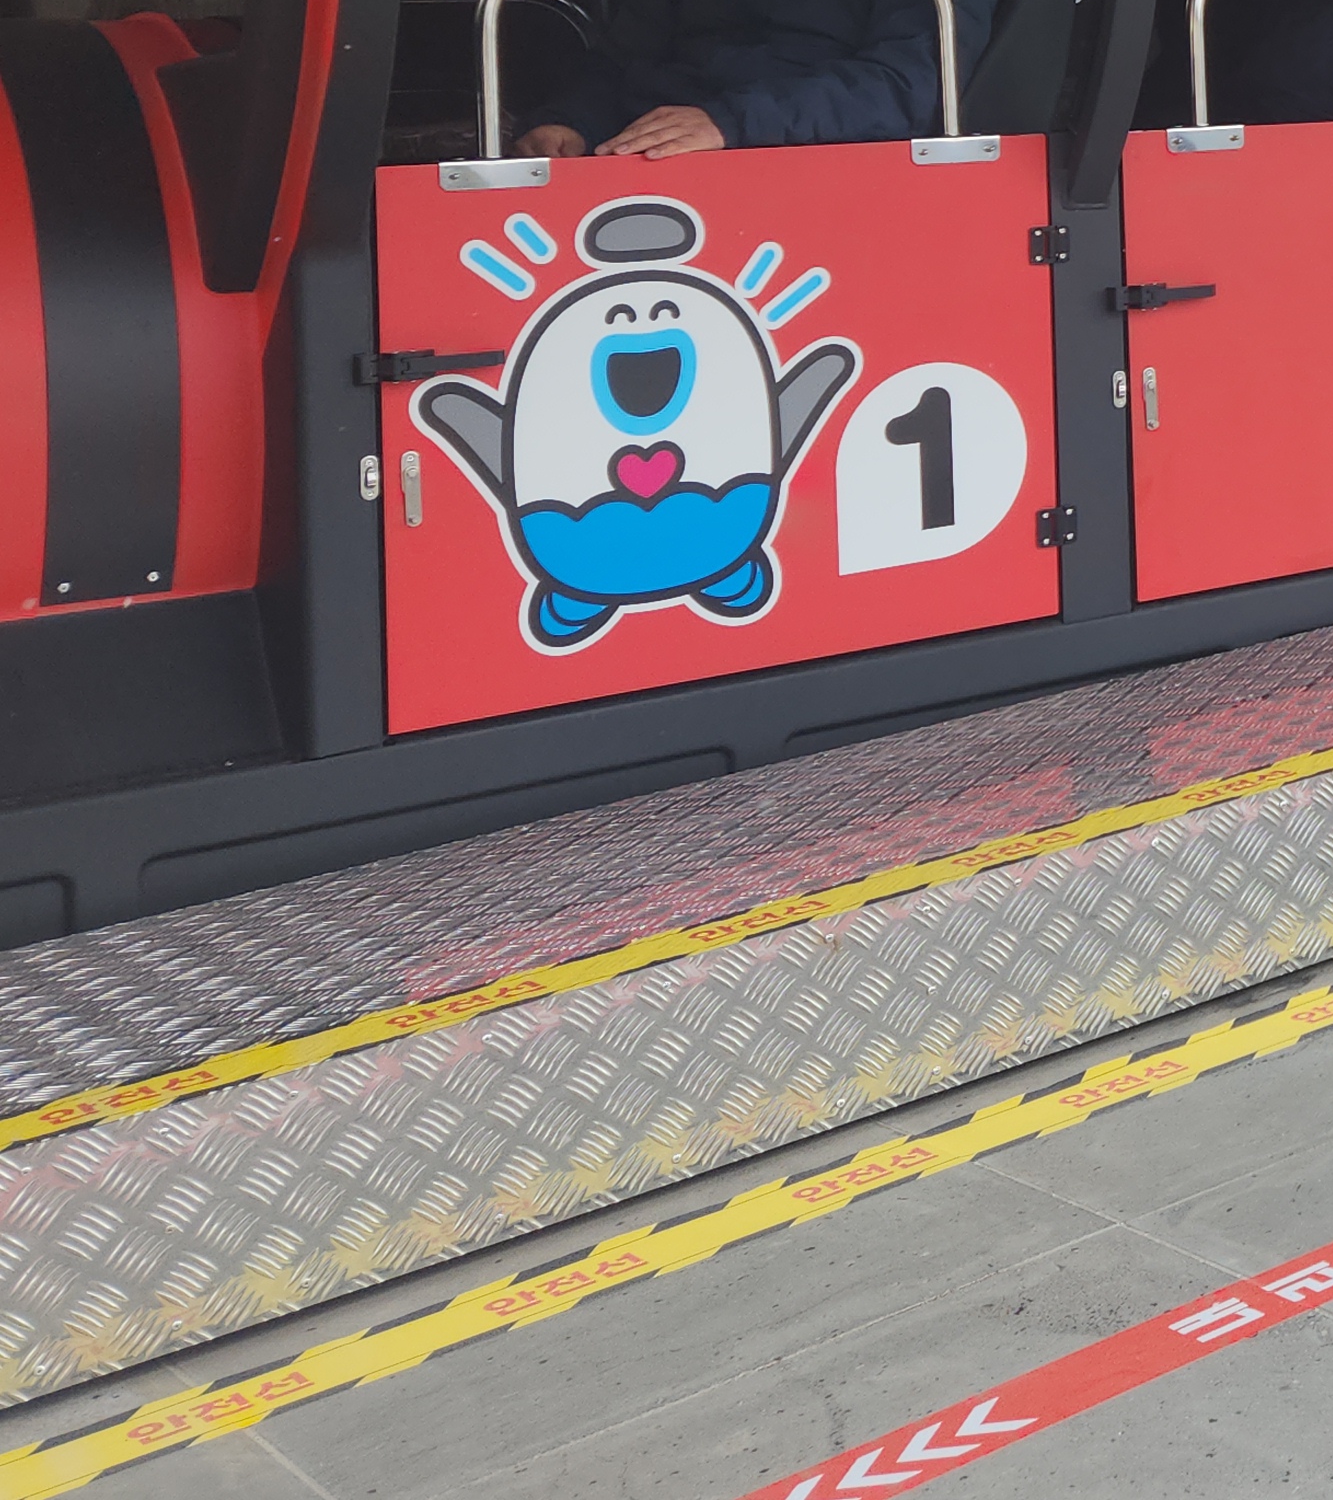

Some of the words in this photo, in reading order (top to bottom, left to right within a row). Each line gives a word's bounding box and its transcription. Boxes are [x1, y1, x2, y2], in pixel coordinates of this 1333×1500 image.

[884, 385, 957, 532] 1
[950, 829, 1080, 869] 안전선
[689, 898, 829, 944] 안전선
[386, 979, 547, 1030] 안전선
[38, 1069, 219, 1127] 안전선
[1058, 1058, 1189, 1109] 안전선
[790, 1145, 941, 1204] 안전선
[483, 1250, 649, 1318] 안전선
[126, 1369, 315, 1446] 안전선
